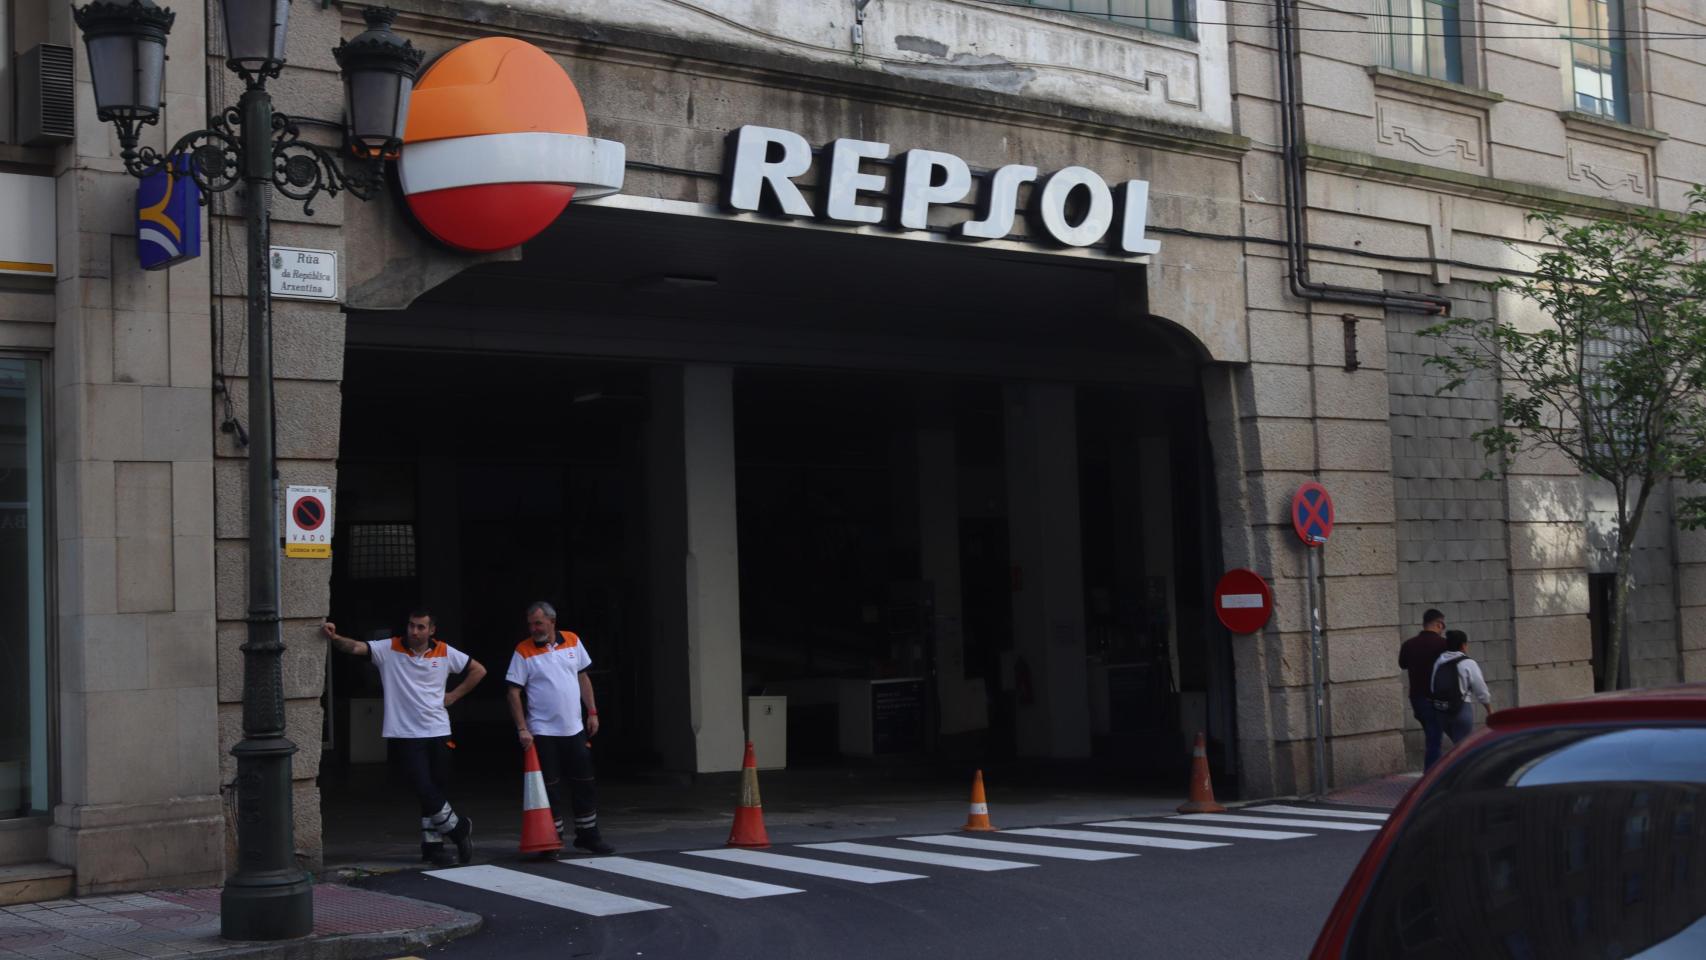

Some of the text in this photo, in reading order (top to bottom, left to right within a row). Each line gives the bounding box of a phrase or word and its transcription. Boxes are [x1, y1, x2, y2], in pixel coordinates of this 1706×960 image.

[729, 124, 1162, 256] REPSOL
[297, 253, 320, 264] Rúa
[292, 269, 331, 282] República
[280, 281, 322, 293] Arxentina
